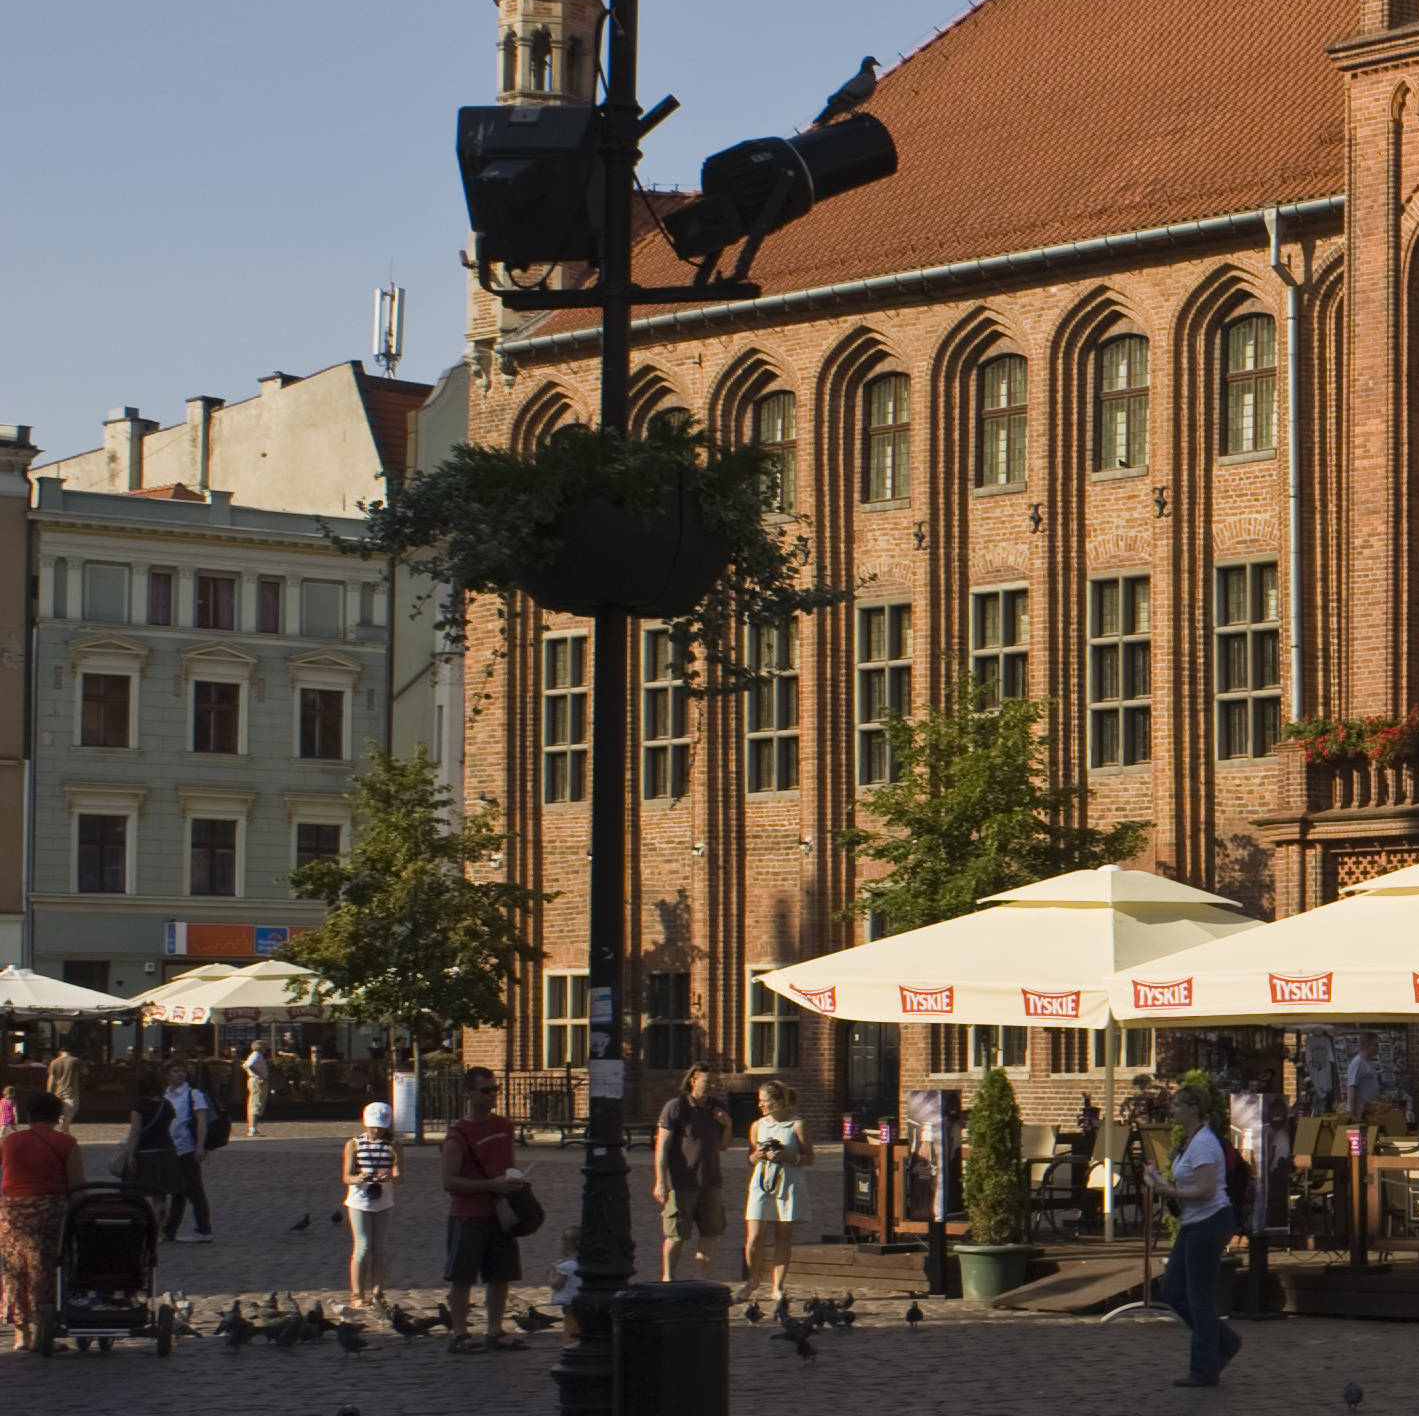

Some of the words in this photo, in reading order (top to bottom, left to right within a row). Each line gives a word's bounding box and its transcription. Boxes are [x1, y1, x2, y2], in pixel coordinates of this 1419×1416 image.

[903, 990, 951, 1011] TYSKIE
[1137, 982, 1190, 1006] TYSKIE
[1272, 978, 1330, 1002] TYSKIE
[1027, 994, 1076, 1015] TYSKIE
